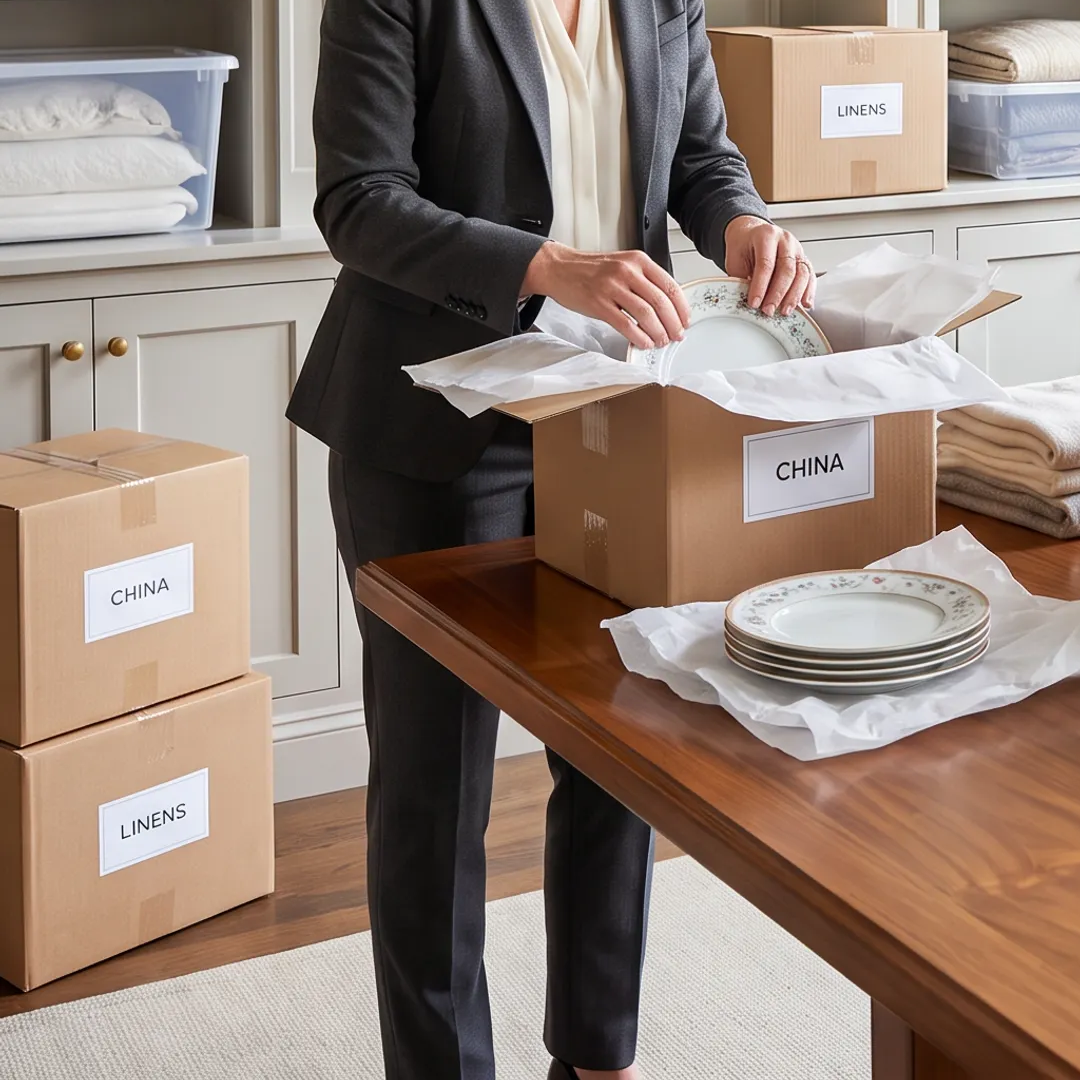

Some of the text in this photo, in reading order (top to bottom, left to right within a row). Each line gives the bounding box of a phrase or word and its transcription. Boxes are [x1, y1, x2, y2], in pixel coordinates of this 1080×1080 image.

[837, 103, 887, 118] LINENS
[775, 452, 845, 482] CHINA
[110, 577, 170, 606] CHINA
[120, 802, 187, 840] LINENS
